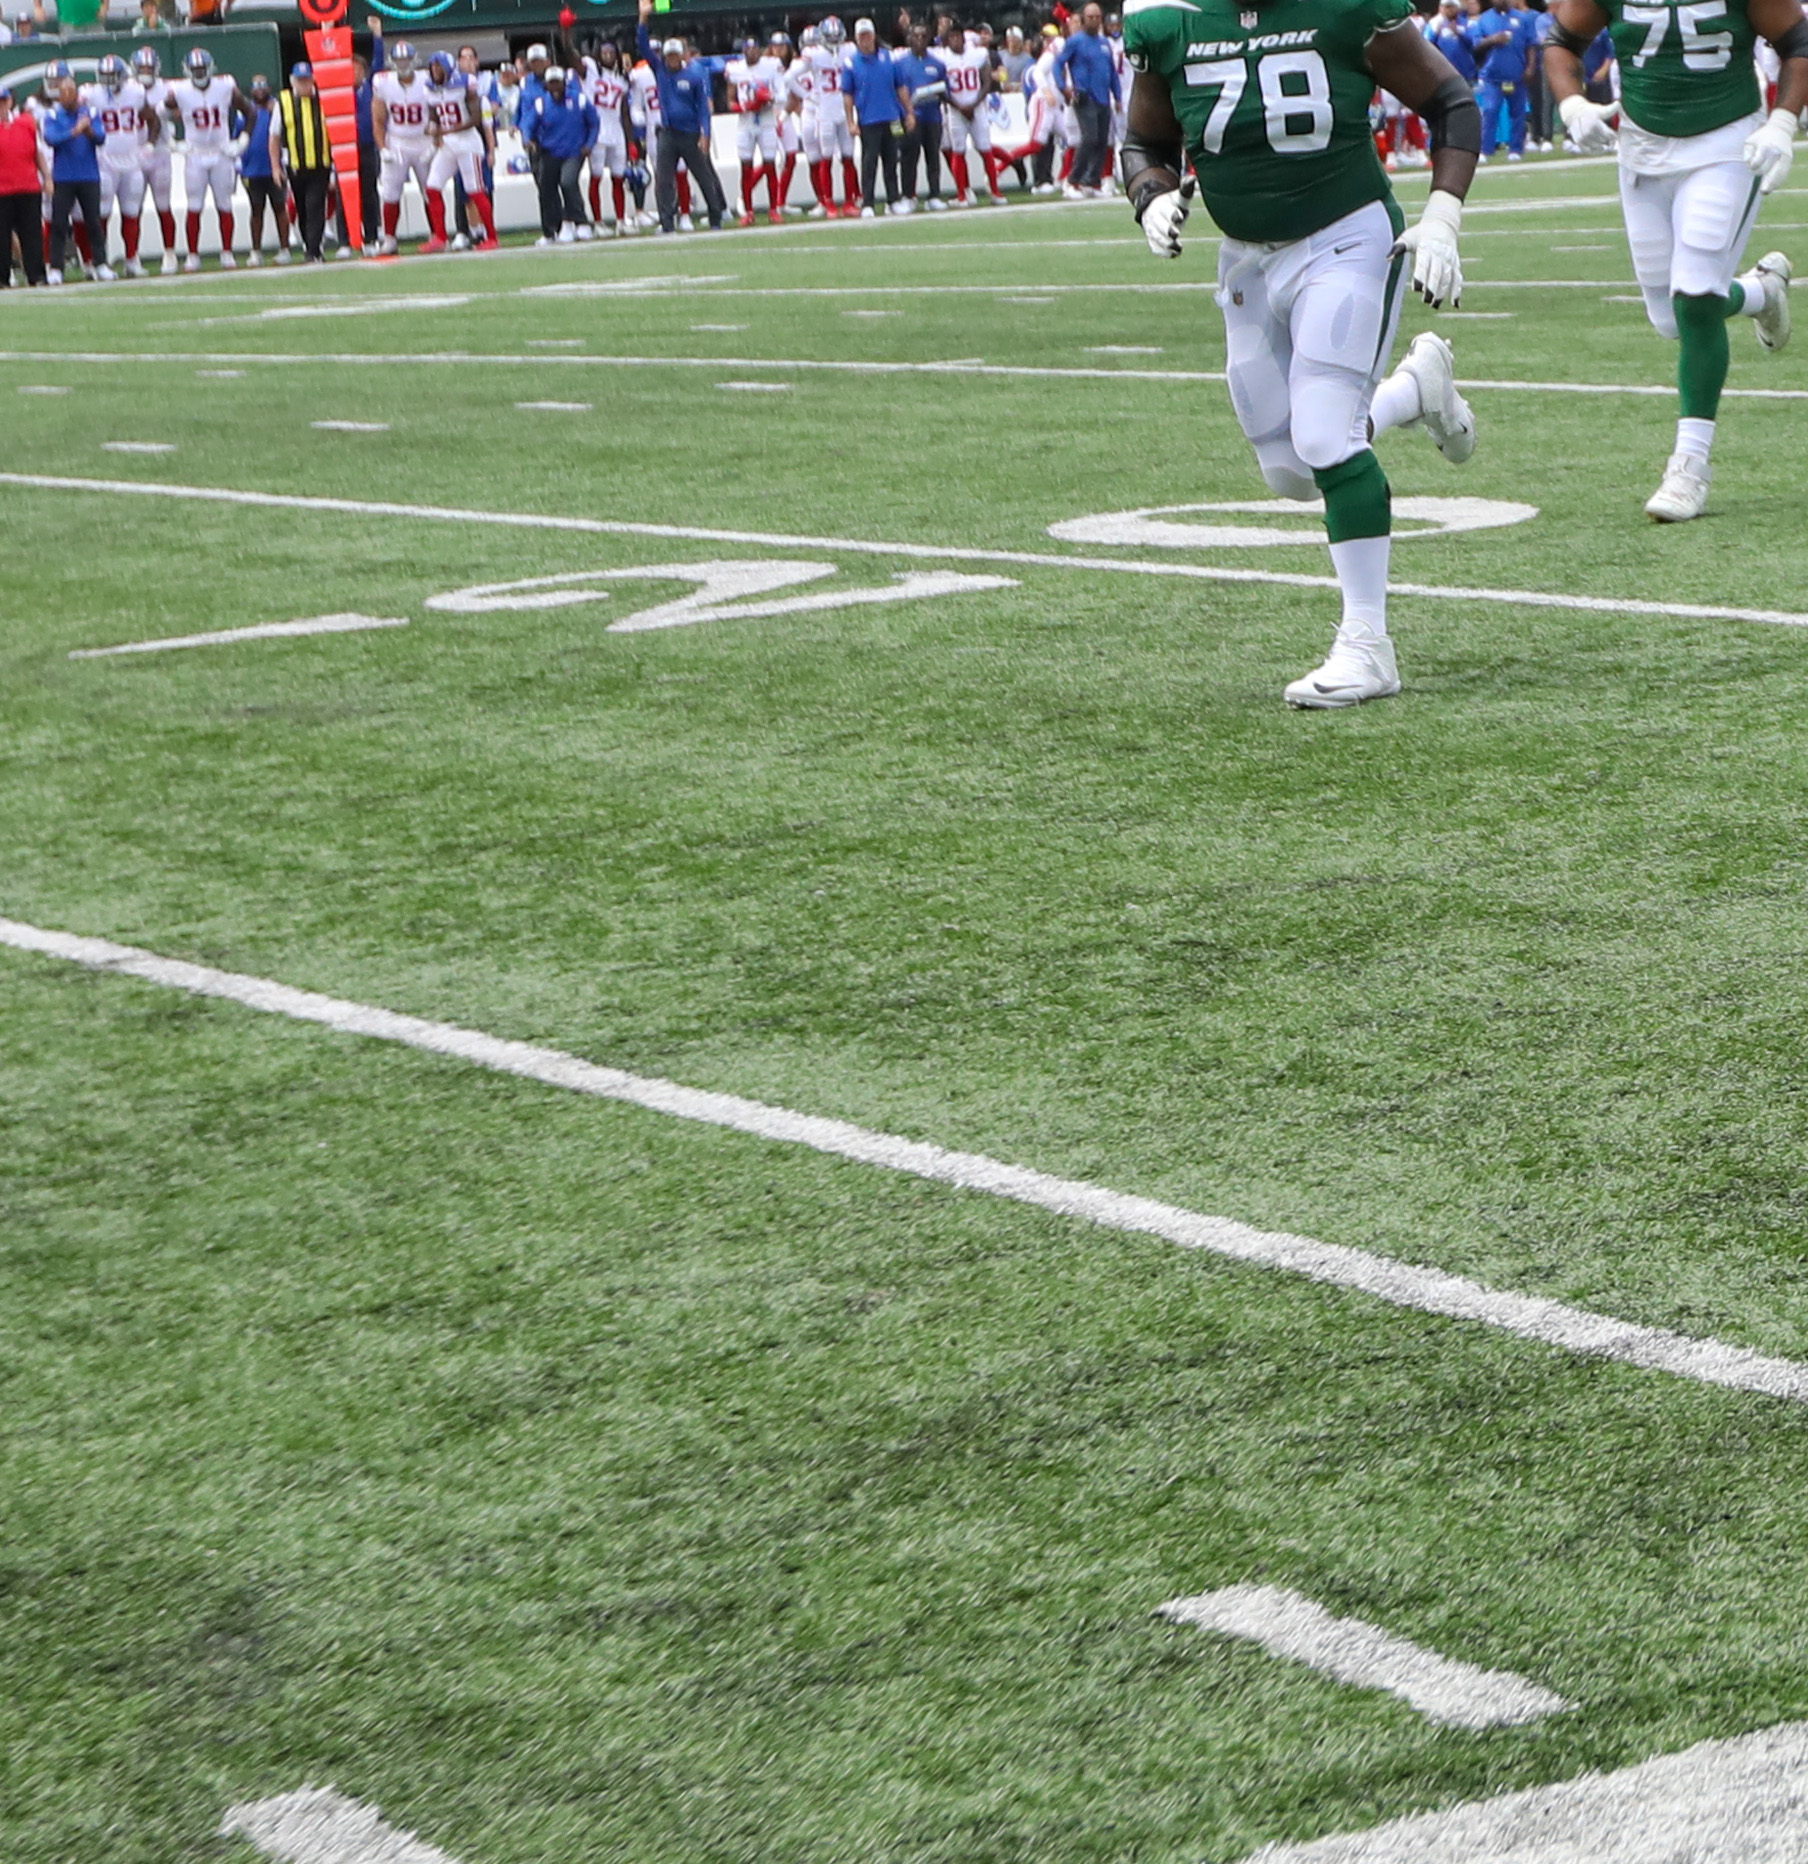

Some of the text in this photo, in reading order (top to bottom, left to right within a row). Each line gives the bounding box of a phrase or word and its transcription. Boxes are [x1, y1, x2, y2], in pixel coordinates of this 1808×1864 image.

[1187, 28, 1319, 58] NEW YORK
[950, 67, 980, 93] 30
[594, 80, 623, 109] 27
[1184, 49, 1334, 155] 78
[102, 107, 138, 133] 93
[192, 107, 222, 131] 91
[390, 103, 424, 126] 98
